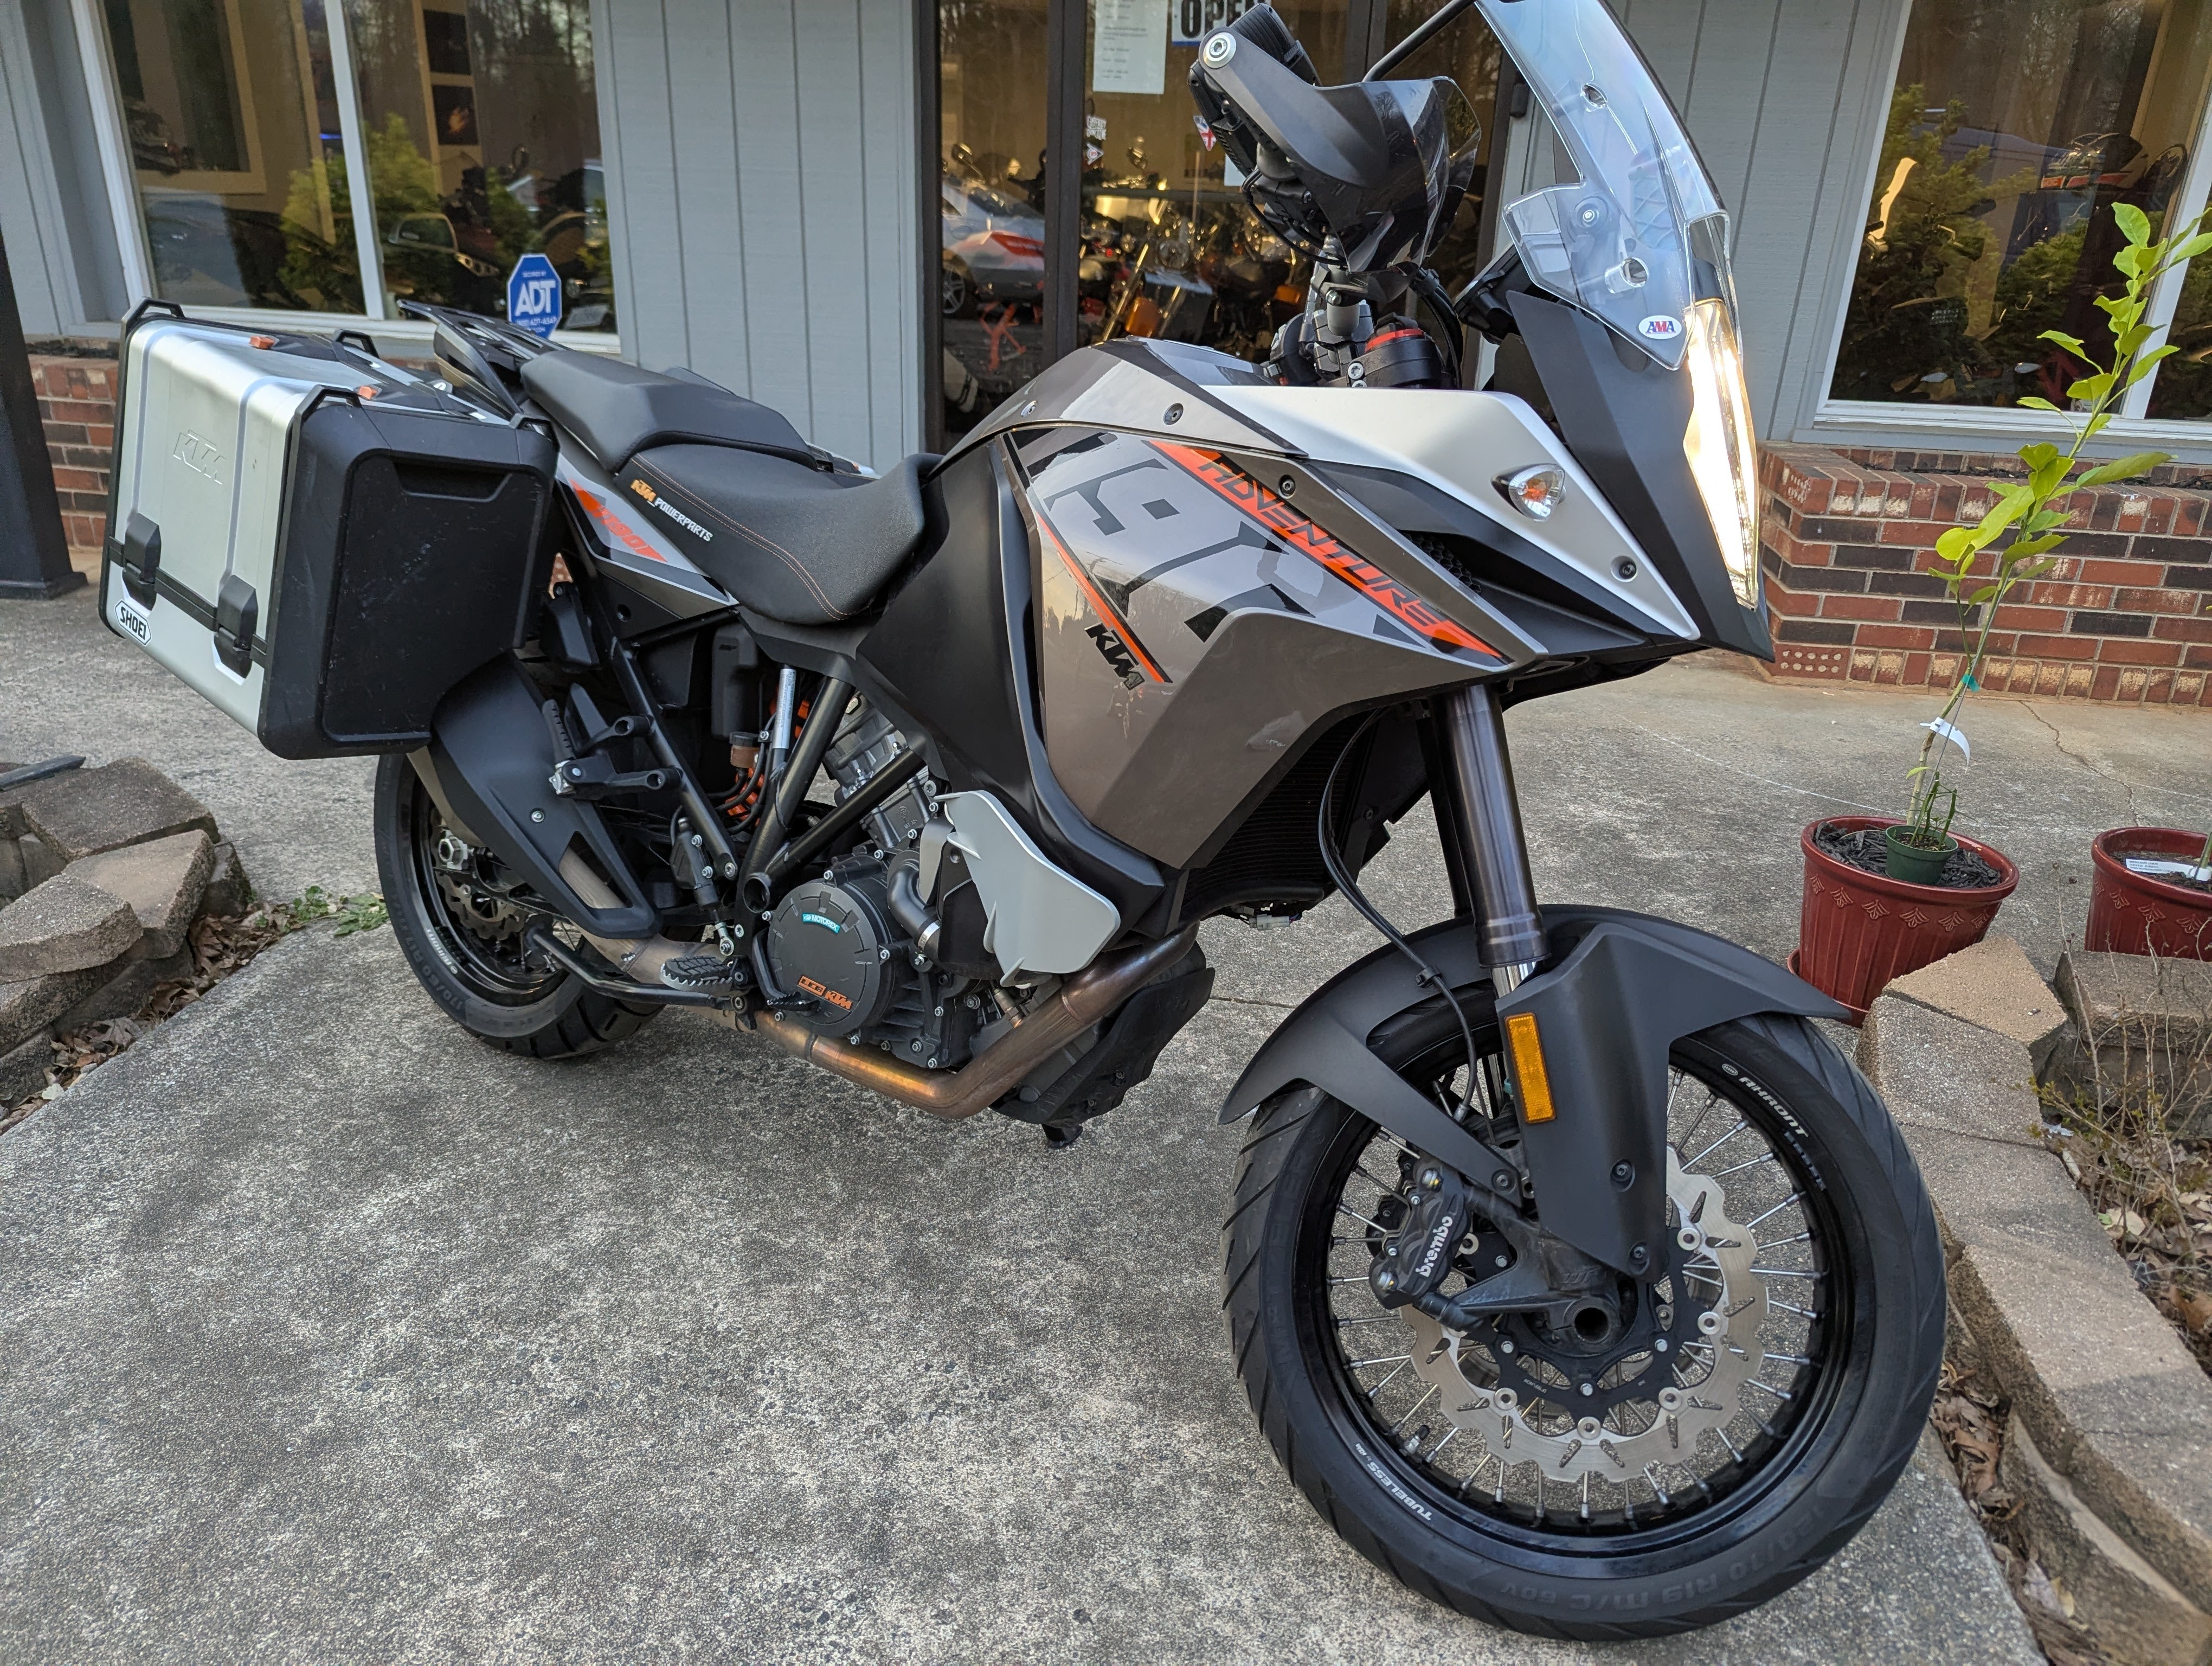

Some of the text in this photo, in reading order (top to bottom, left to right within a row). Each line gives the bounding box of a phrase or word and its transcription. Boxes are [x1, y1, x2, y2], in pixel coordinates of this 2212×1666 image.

[1181, 0, 1265, 38] OPE
[515, 280, 556, 316] ADT
[1645, 321, 1675, 332] AMA
[173, 430, 227, 485] KTM
[630, 479, 713, 542] KTM POWERPARTS
[1197, 454, 1442, 628] ADVENTURE
[120, 606, 146, 640] SHOEI
[1084, 624, 1145, 690] KTM
[812, 914, 838, 931] MOTOREX
[824, 990, 852, 1009] KTM
[1739, 1077, 1809, 1137] AKRONT
[1416, 1216, 1452, 1277] brembo
[1367, 1462, 1432, 1520] TUBELESS
